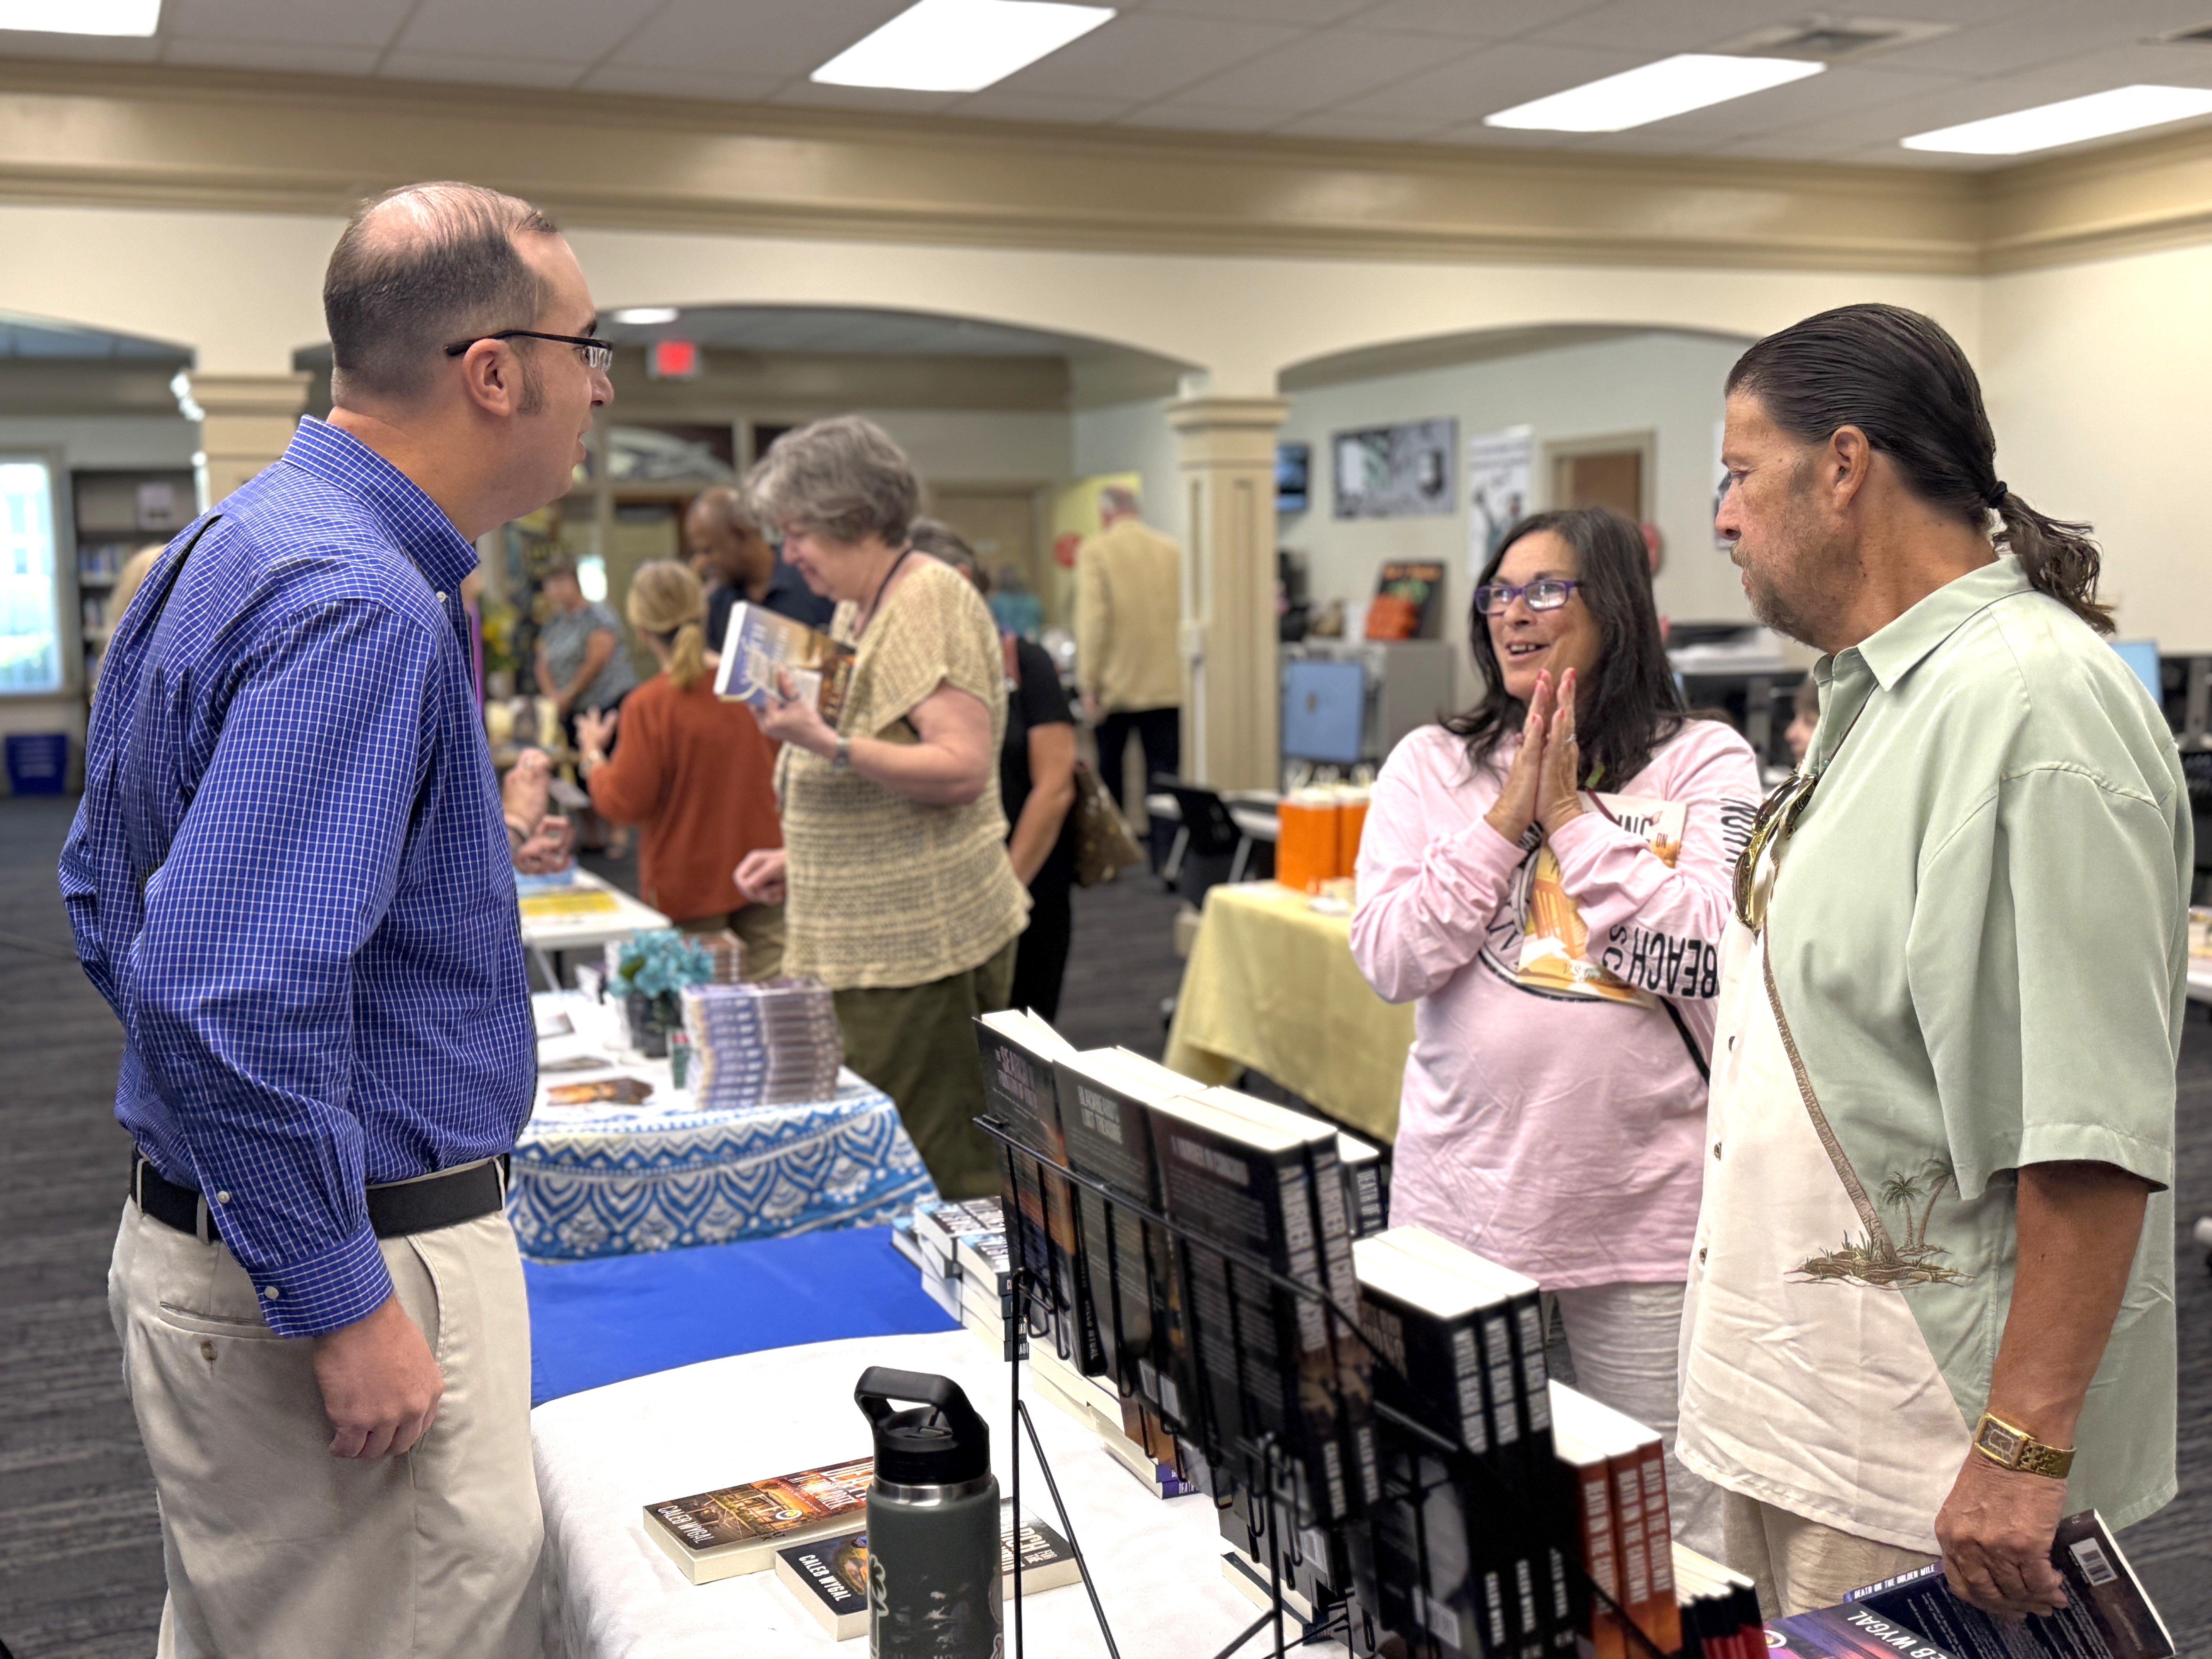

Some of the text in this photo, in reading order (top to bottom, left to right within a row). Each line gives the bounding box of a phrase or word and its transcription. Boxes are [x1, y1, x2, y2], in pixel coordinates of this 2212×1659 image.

[1656, 833, 1668, 848] ON
[1628, 927, 1717, 998] BEACH
[1357, 1170, 1381, 1229] DEATH OF A
[1619, 1470, 1638, 1506] DEATH
[1642, 1459, 1663, 1495] DEATH
[815, 1489, 859, 1510] CREEK
[1585, 1480, 1607, 1516] DEATH
[658, 1505, 714, 1544] CALEB WYGAL
[1624, 1521, 1643, 1546] THE
[1647, 1511, 1667, 1534] THE
[1591, 1532, 1611, 1556] THE
[799, 1554, 852, 1602] CALEB WYGAL
[1854, 1564, 1935, 1599] DEATH ON THE GOLDEN MILE
[1847, 1611, 1917, 1649] WYGAL
